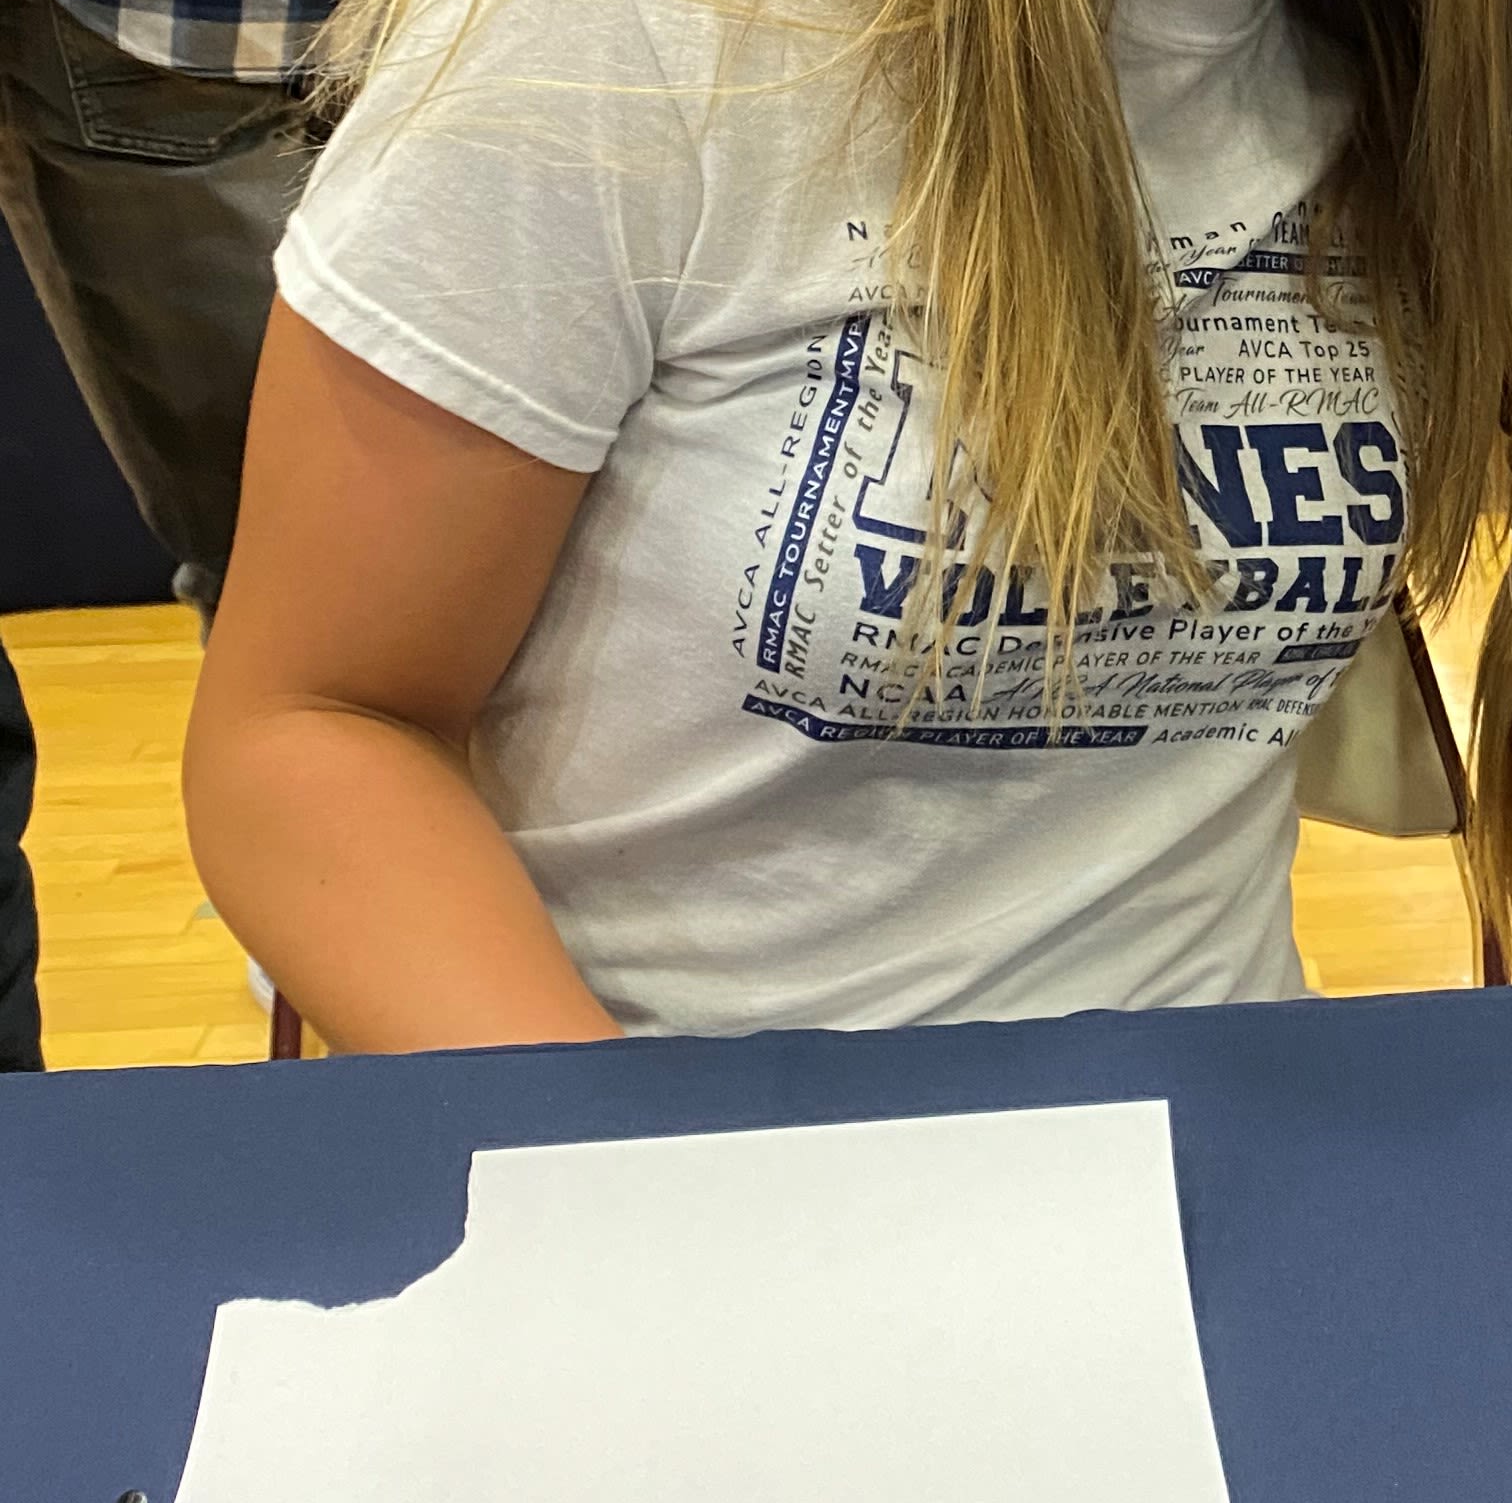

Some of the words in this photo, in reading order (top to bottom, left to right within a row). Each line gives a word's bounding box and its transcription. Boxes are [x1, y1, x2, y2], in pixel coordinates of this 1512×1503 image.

[1238, 339, 1293, 359] AVCA
[1299, 340, 1340, 361] Top
[1348, 340, 1371, 358] 25
[1180, 366, 1245, 384] PLAYER
[1253, 368, 1277, 384] OF
[1285, 368, 1323, 384] THE
[1329, 366, 1376, 383] YEAR
[1176, 387, 1220, 417] Team
[785, 603, 816, 680] RMAC
[804, 496, 846, 592] Setter
[844, 441, 863, 479] of
[857, 388, 883, 433] the
[732, 564, 761, 658] AVCA
[763, 589, 787, 664] RMAC
[1168, 618, 1266, 646] Player
[1277, 622, 1309, 642] of
[1317, 621, 1353, 640] the
[1136, 650, 1162, 666] OF
[1169, 650, 1203, 665] THE
[1212, 650, 1261, 665] YEAR
[754, 678, 827, 712] AVCA
[1154, 701, 1242, 718] MENTION
[1305, 667, 1337, 700] of
[750, 700, 810, 732] AVCA
[920, 729, 1003, 746] PLAYER
[1089, 728, 1138, 744] YEAR
[1153, 722, 1259, 745] Academic
